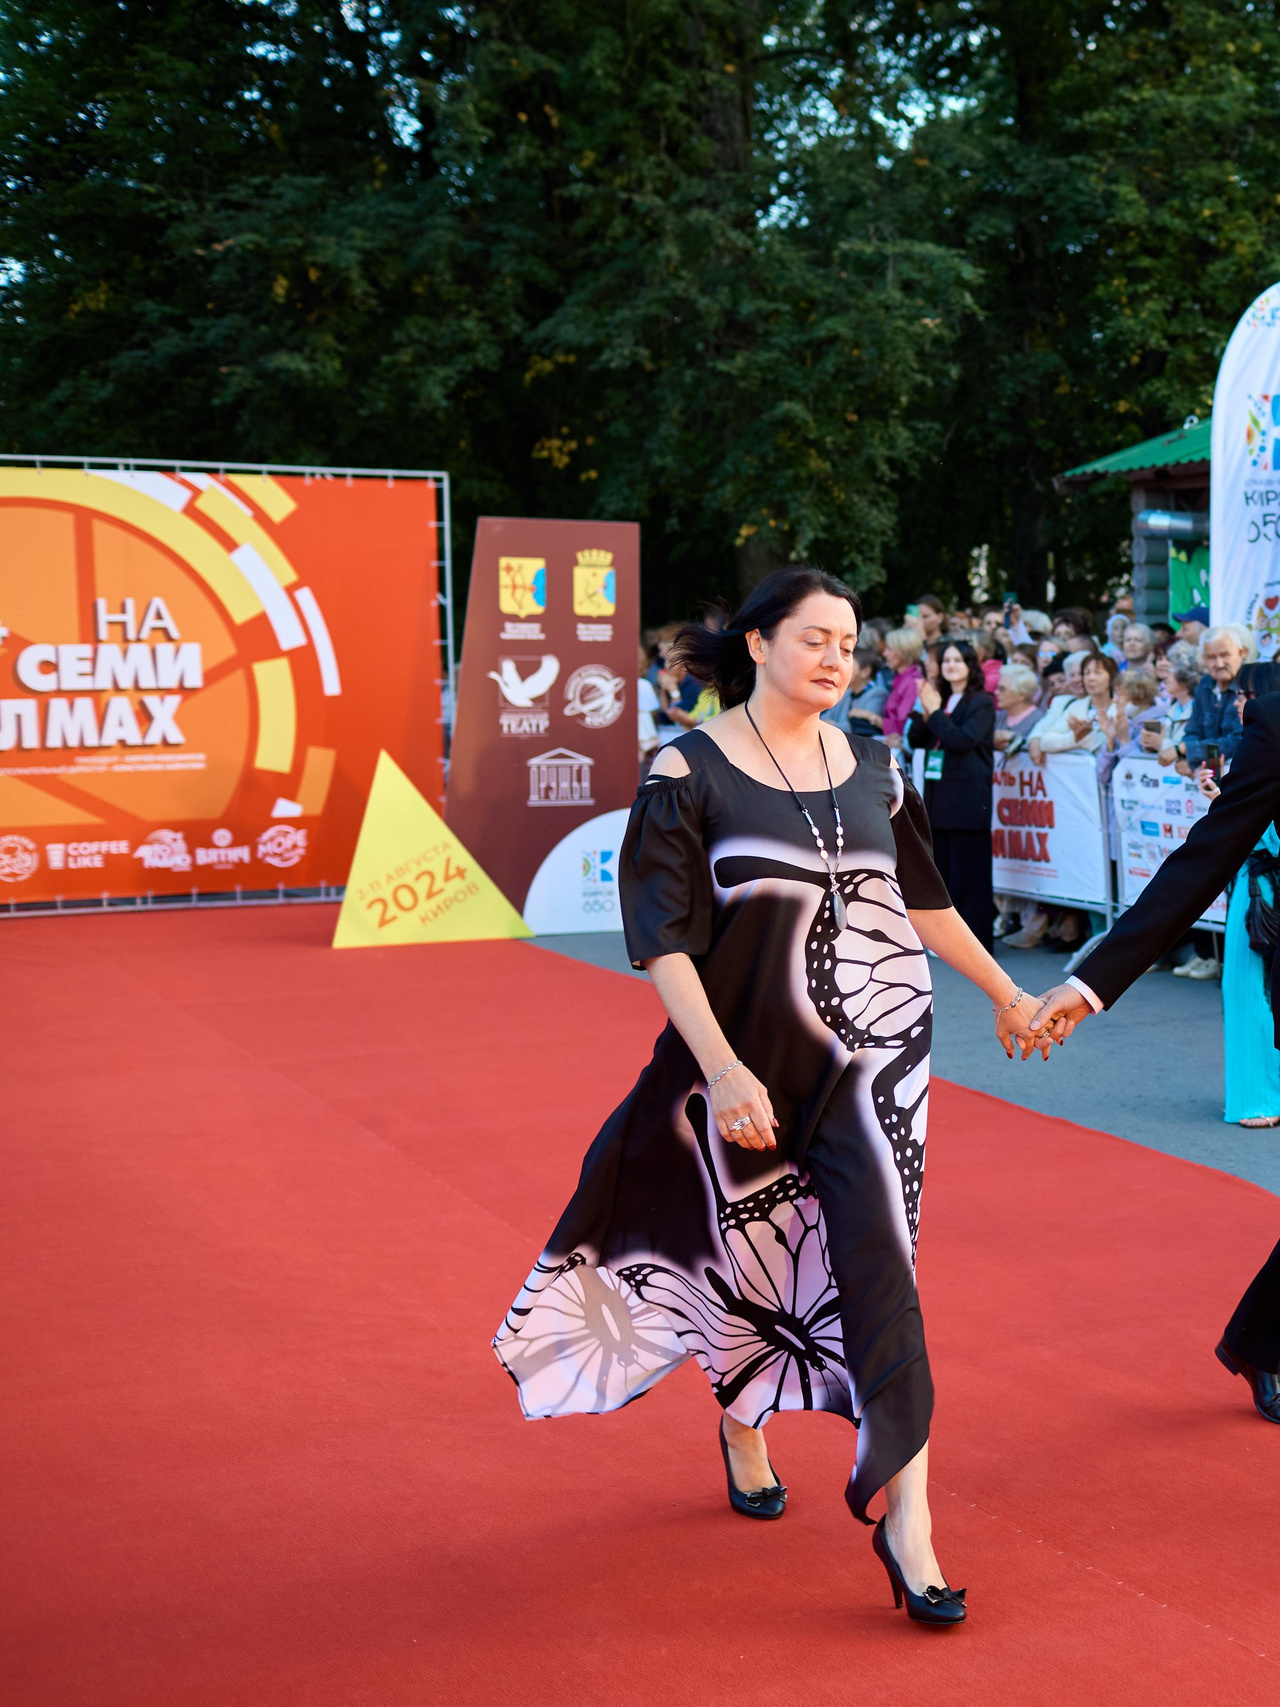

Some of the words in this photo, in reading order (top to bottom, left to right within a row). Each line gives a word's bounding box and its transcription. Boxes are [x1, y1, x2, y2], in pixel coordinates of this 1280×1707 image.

[95, 596, 181, 641] НА
[15, 642, 203, 692] СЕМИ
[1019, 770, 1047, 797] НА
[997, 798, 1055, 829] СЕМИ
[67, 840, 130, 855] COFFEE
[67, 854, 105, 869] LIKE
[386, 841, 453, 884] АВГУСТА
[991, 828, 1051, 863] ЛМАХ
[366, 857, 467, 929] 2024
[418, 880, 480, 927] КИРОВ
